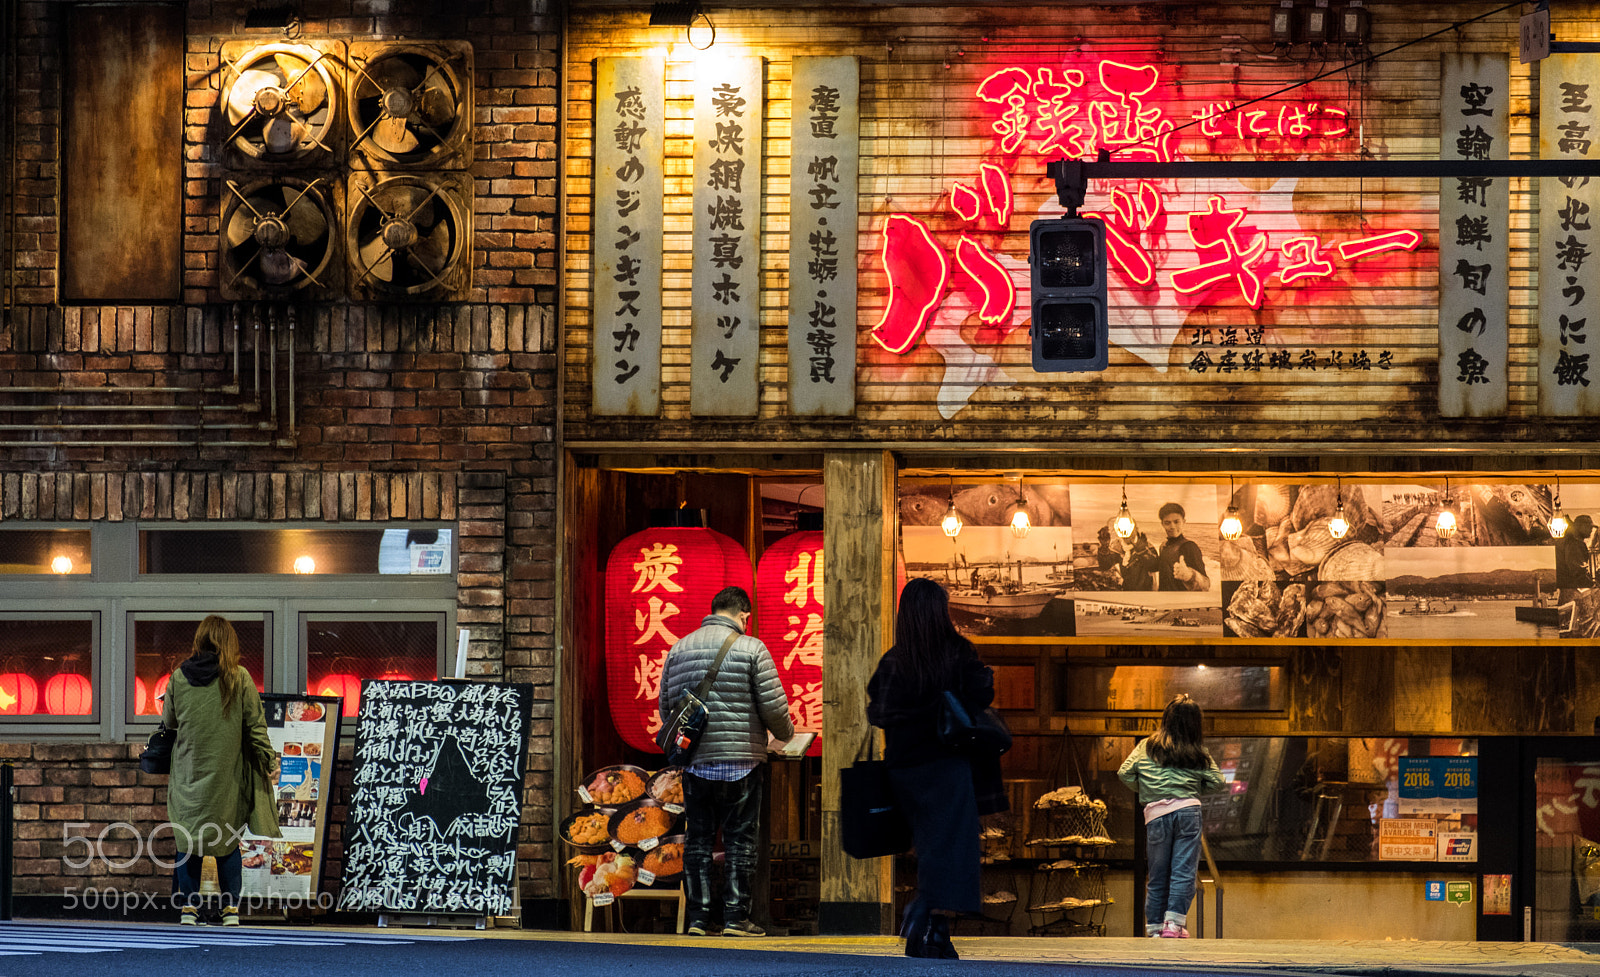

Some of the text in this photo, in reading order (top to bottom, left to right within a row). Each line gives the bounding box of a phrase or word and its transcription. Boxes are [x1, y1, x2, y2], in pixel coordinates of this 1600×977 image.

[1191, 100, 1350, 140] ぜにばこ
[613, 85, 647, 385] 感動のジンギスカン
[707, 83, 745, 384] 豪快網焼真ホッケ
[1191, 326, 1267, 347] 北海道
[1403, 772, 1430, 787] 2018
[1444, 772, 1471, 787] 2018
[1383, 821, 1434, 830] ENGLISH MENU
[1383, 829, 1421, 837] AVAILABLE
